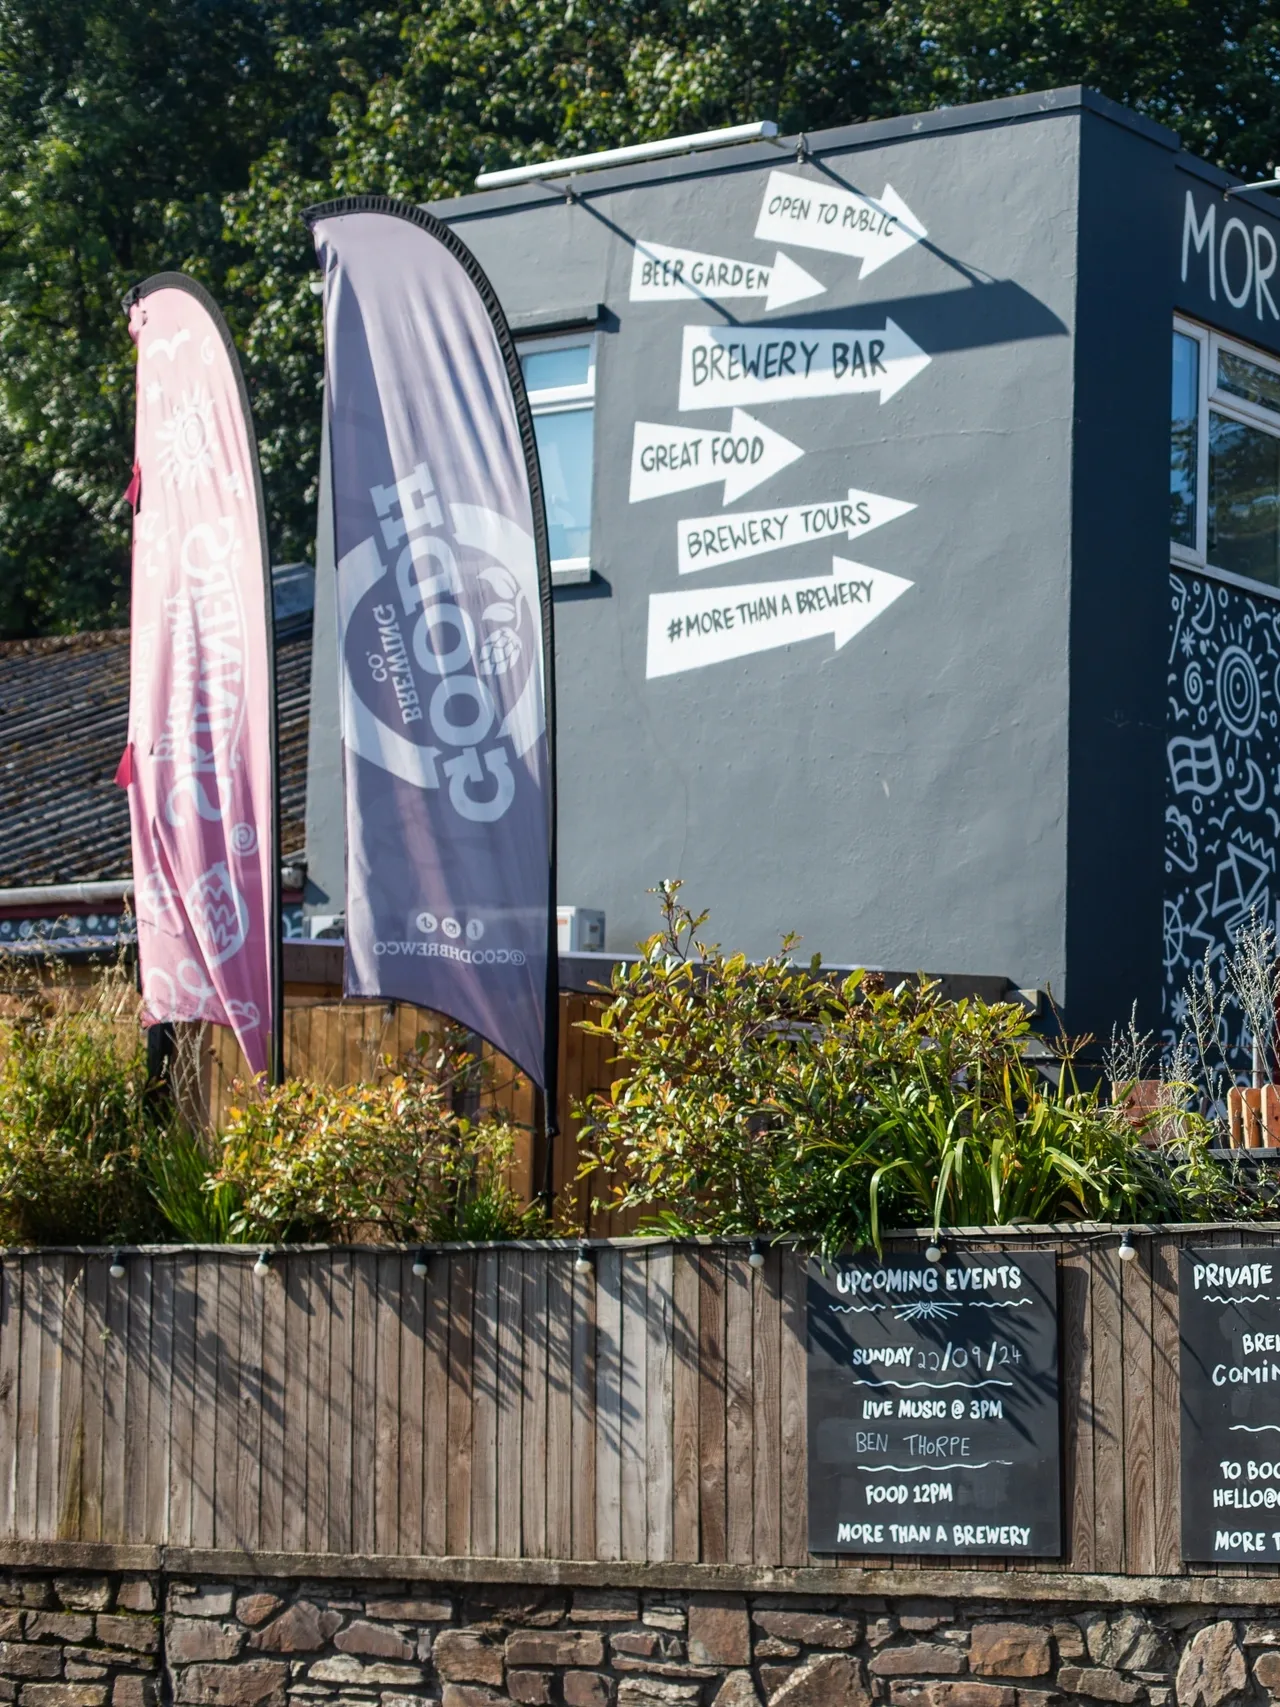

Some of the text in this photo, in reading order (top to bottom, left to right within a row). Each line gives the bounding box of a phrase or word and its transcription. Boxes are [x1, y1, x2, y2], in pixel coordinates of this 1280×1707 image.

[768, 196, 899, 238] OPEN TO PUBLIC
[641, 259, 770, 289] BEER GARDEN
[691, 339, 888, 386] BREWERY BAR
[640, 436, 765, 473] GREAT FOOD
[687, 501, 871, 558] BREWERY TOURS
[666, 579, 875, 643] #MORE THAN A BREWERY
[836, 1265, 1023, 1296] UPCOMING EVENTS
[1193, 1262, 1274, 1290] PRIVATE
[852, 1346, 914, 1368] SUNDAY
[862, 1399, 1003, 1420] LIVE MUSIC @ 3PM
[855, 1431, 889, 1454] BEN
[1220, 1461, 1242, 1480] TO
[865, 1482, 953, 1506] FOOD 12PM
[836, 1522, 1031, 1547] MORE THAN A BREWERY
[1214, 1530, 1266, 1552] MORE
